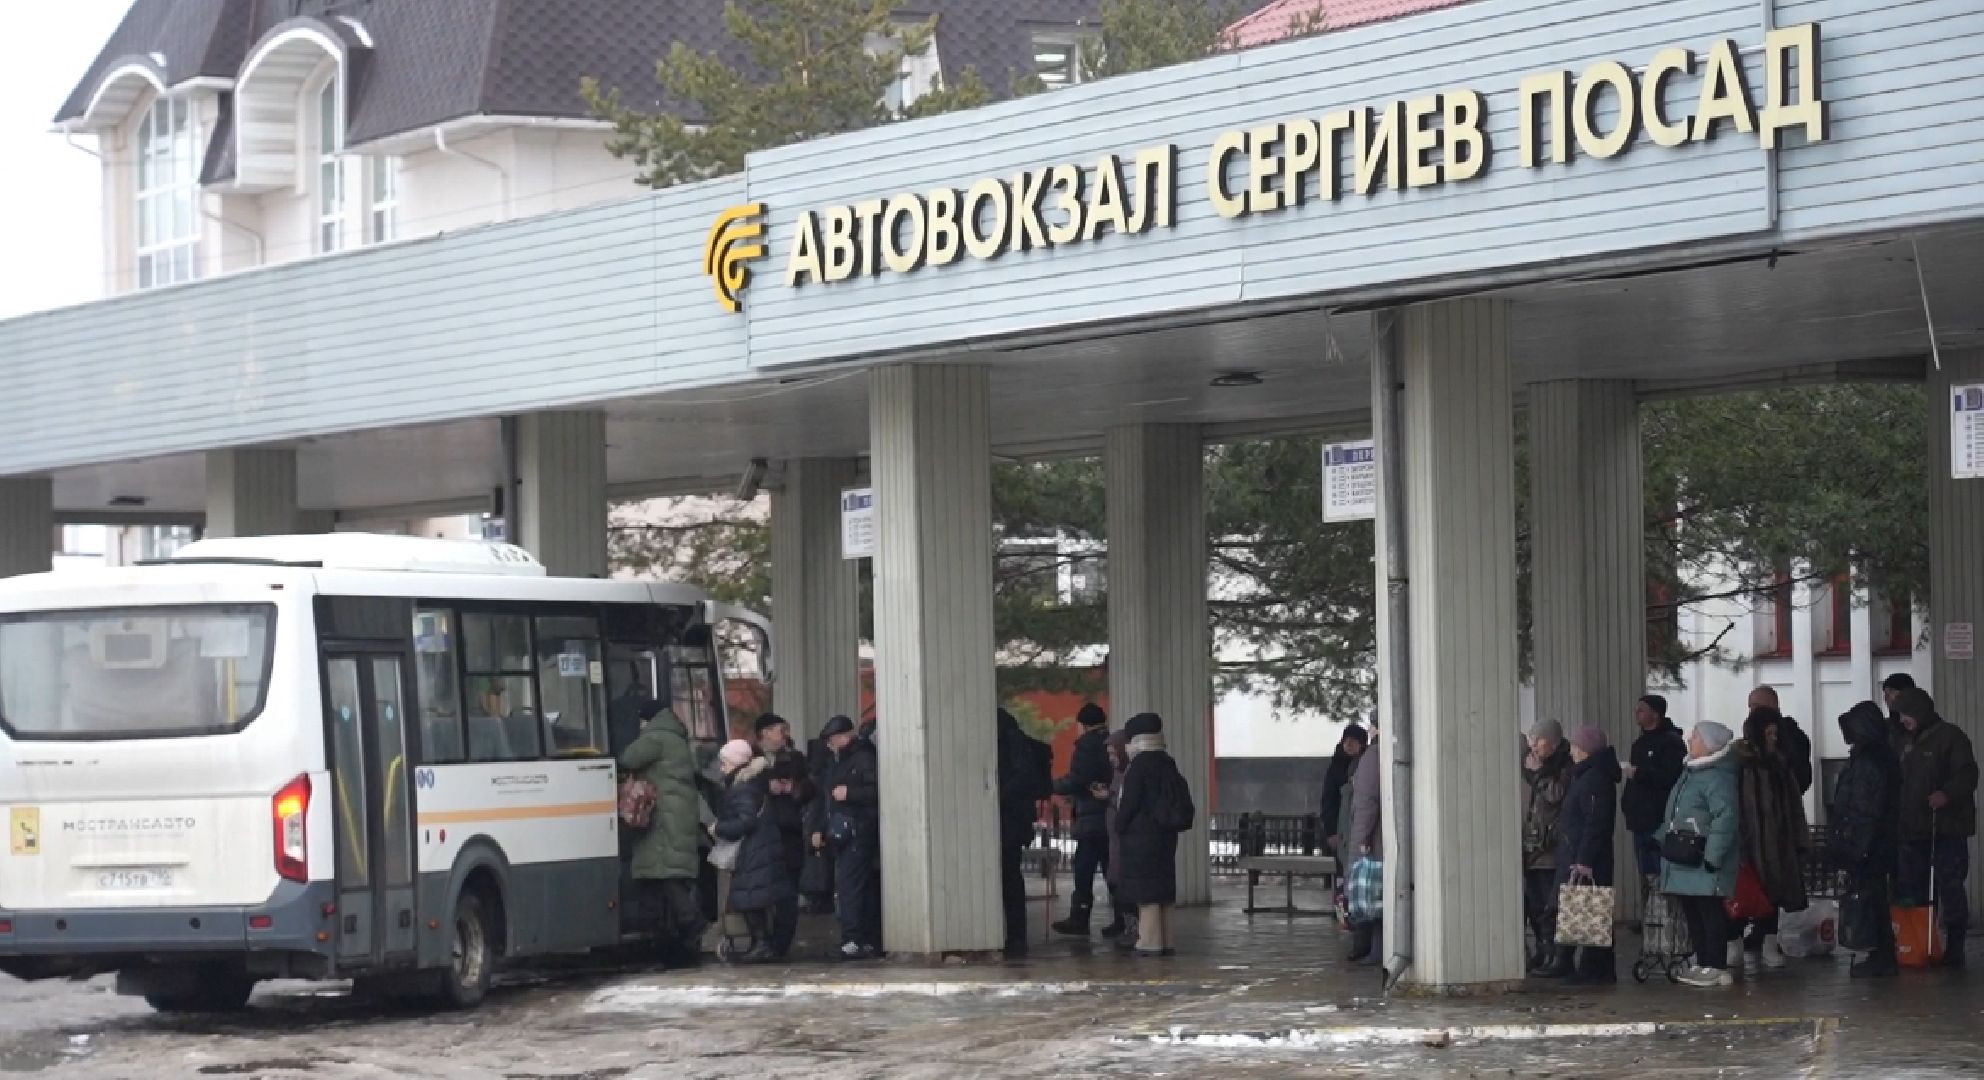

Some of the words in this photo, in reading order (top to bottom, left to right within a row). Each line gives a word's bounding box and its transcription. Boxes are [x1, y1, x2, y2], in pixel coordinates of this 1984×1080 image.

[785, 143, 1177, 287] АВТОВОКЗАЛ
[1208, 89, 1485, 218] СЕРГИЕВ
[1520, 21, 1828, 168] ПОСАД
